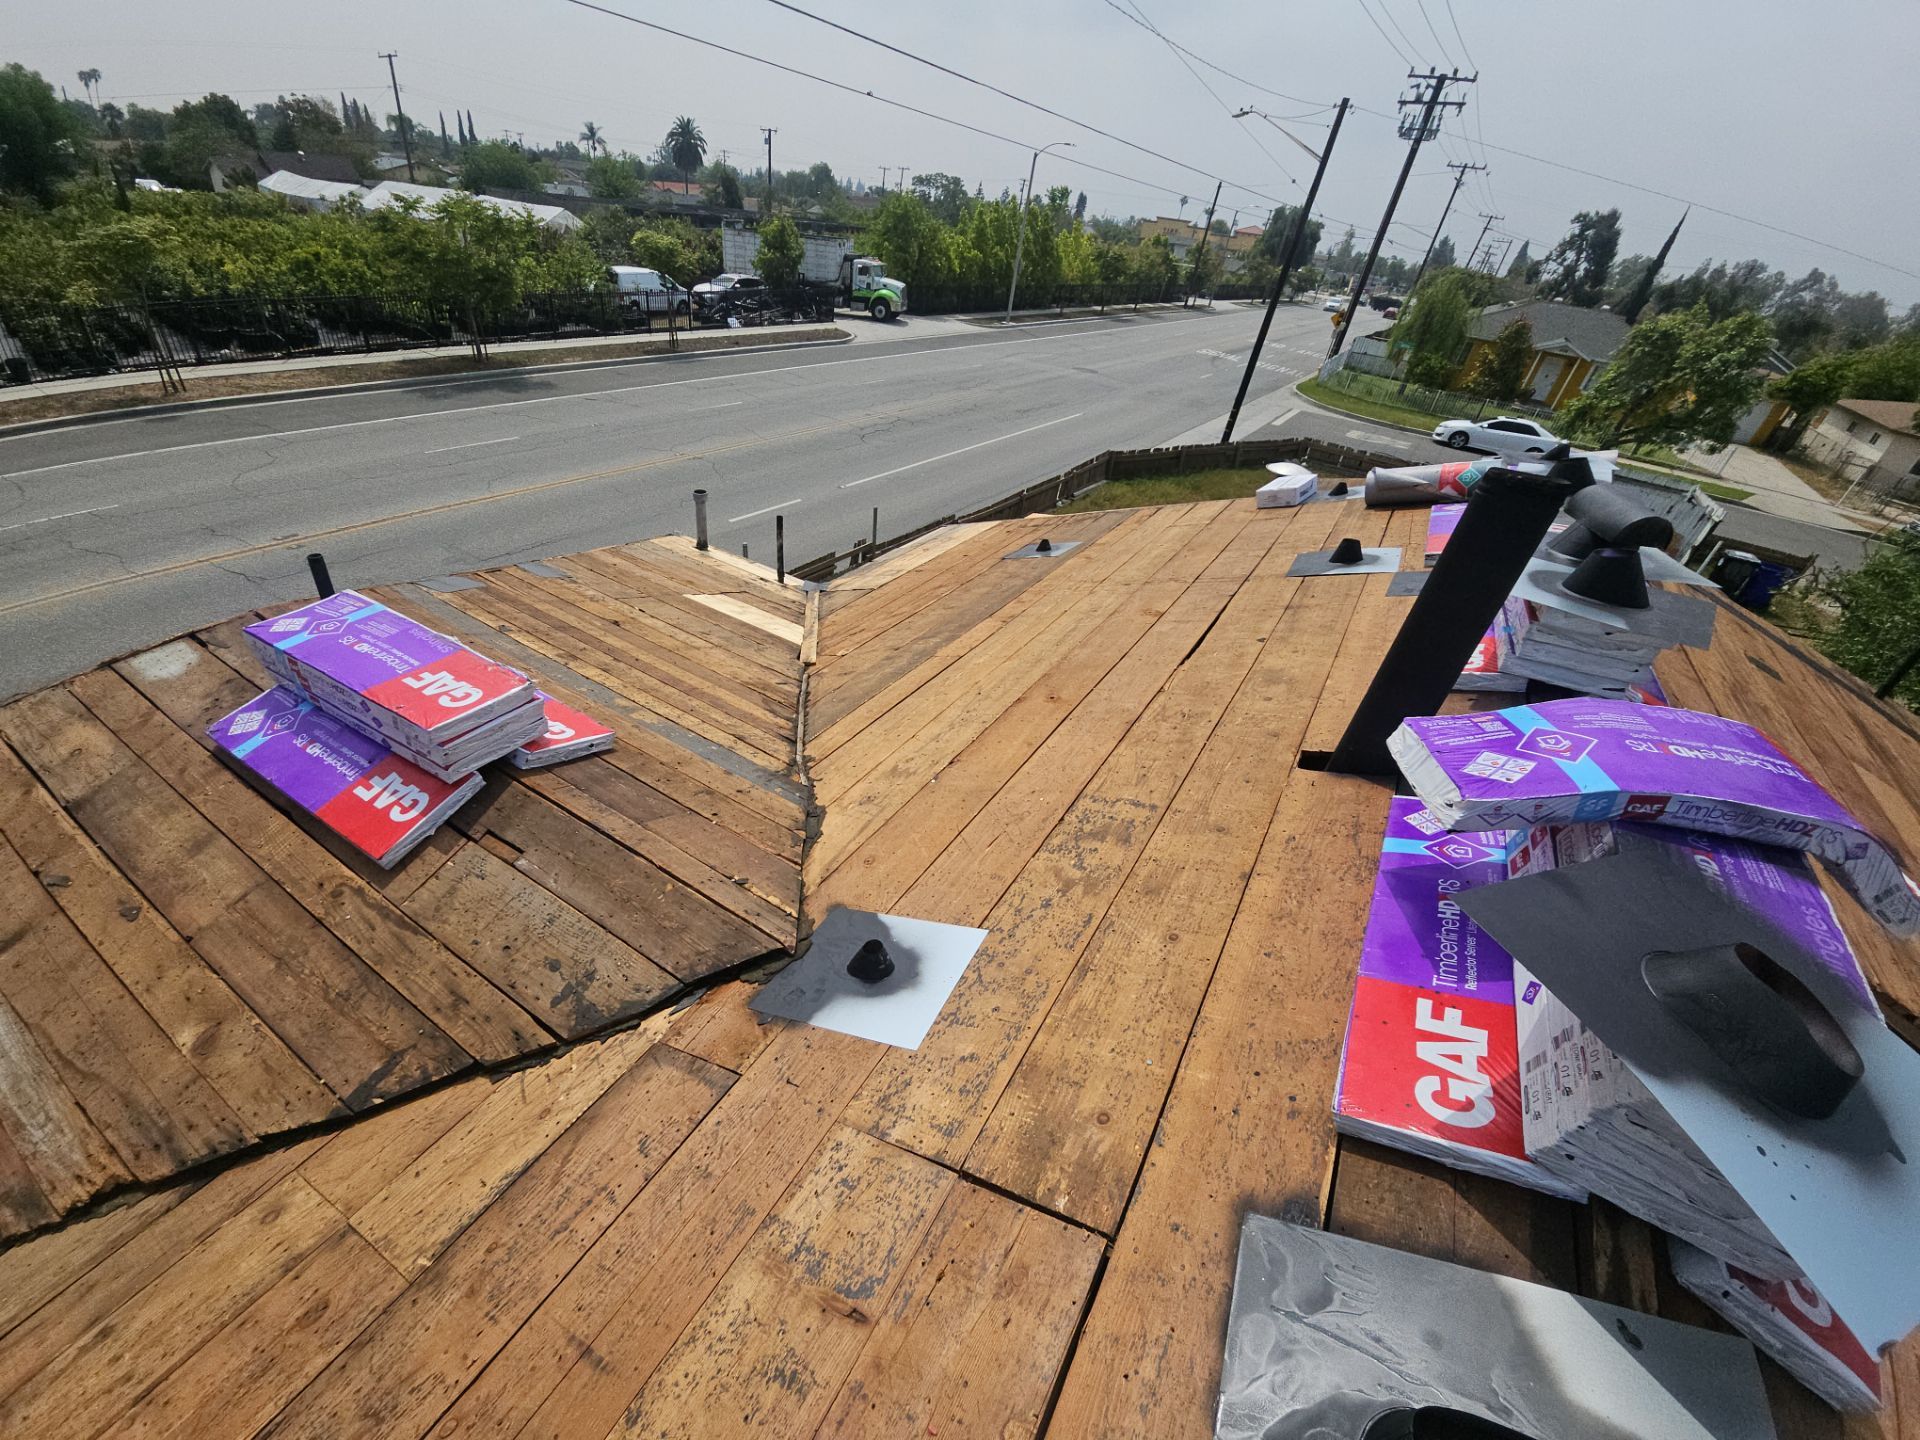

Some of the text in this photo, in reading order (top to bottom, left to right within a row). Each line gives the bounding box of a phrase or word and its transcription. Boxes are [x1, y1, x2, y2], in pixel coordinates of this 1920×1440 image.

[402, 671, 483, 707] GAF
[1625, 739, 1664, 753] RS
[353, 772, 430, 822] GAF
[1628, 803, 1663, 814] GAF
[1438, 879, 1461, 894] RS
[1465, 956, 1477, 990] Reflector
[1414, 997, 1496, 1128] GAF
[1589, 1049, 1600, 1063] 01
[1560, 1064, 1570, 1078] 01
